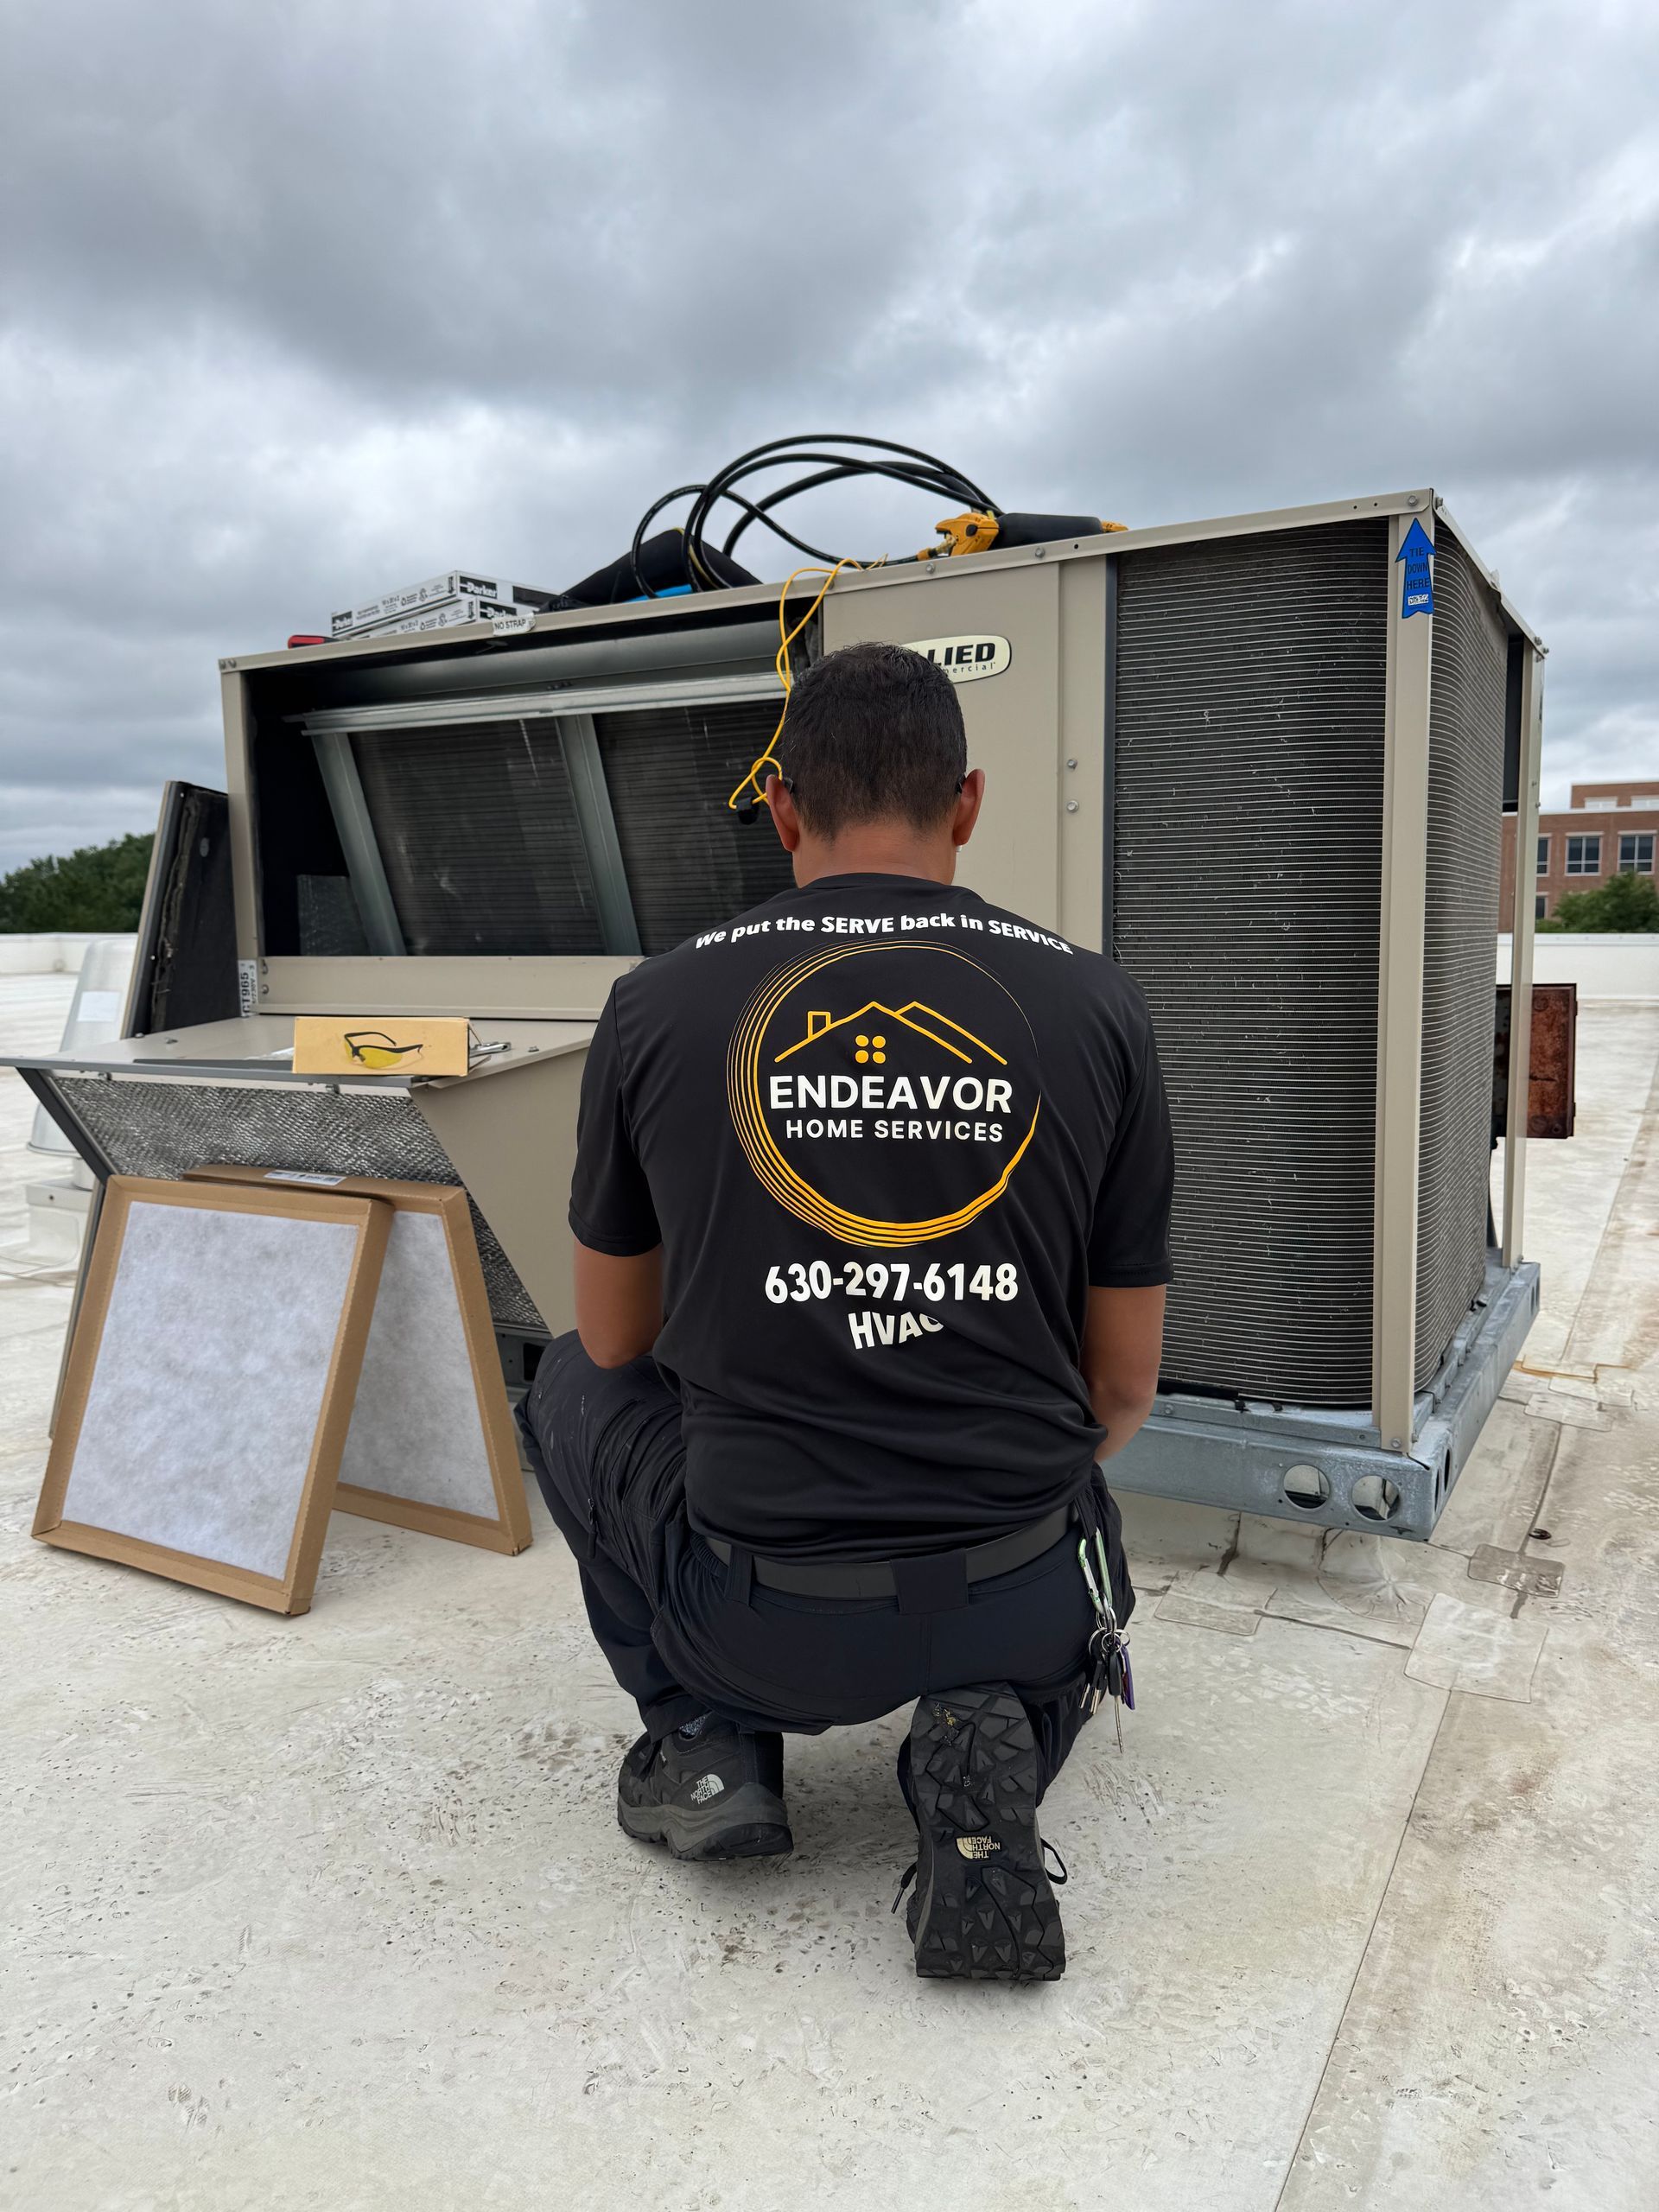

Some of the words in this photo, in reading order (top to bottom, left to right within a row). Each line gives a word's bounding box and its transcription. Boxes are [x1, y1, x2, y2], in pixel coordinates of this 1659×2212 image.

[1410, 548, 1425, 557] TIE
[1408, 563, 1428, 575] DOWN
[467, 582, 498, 597] Parker
[1407, 578, 1430, 591] HERE
[494, 621, 505, 630] NO
[505, 619, 526, 629] STRAP
[927, 642, 995, 666] LIED
[942, 663, 993, 673] mercial
[696, 931, 726, 949] We
[731, 921, 772, 944] put
[776, 917, 815, 931] the
[821, 917, 894, 934] SERVE
[901, 913, 957, 931] back
[961, 915, 983, 931] in
[988, 920, 1074, 955] SERVICE
[769, 1076, 1013, 1114] ENDEAVOR
[786, 1119, 863, 1139] HOME
[874, 1120, 1003, 1142] SERVICES
[765, 1261, 1019, 1304] 630-297-6148
[696, 1776, 709, 1789] THE
[690, 1783, 710, 1801] NORTH
[697, 1790, 713, 1805] FACE
[971, 1835, 992, 1844] FACE
[972, 1842, 1001, 1851] NORTH
